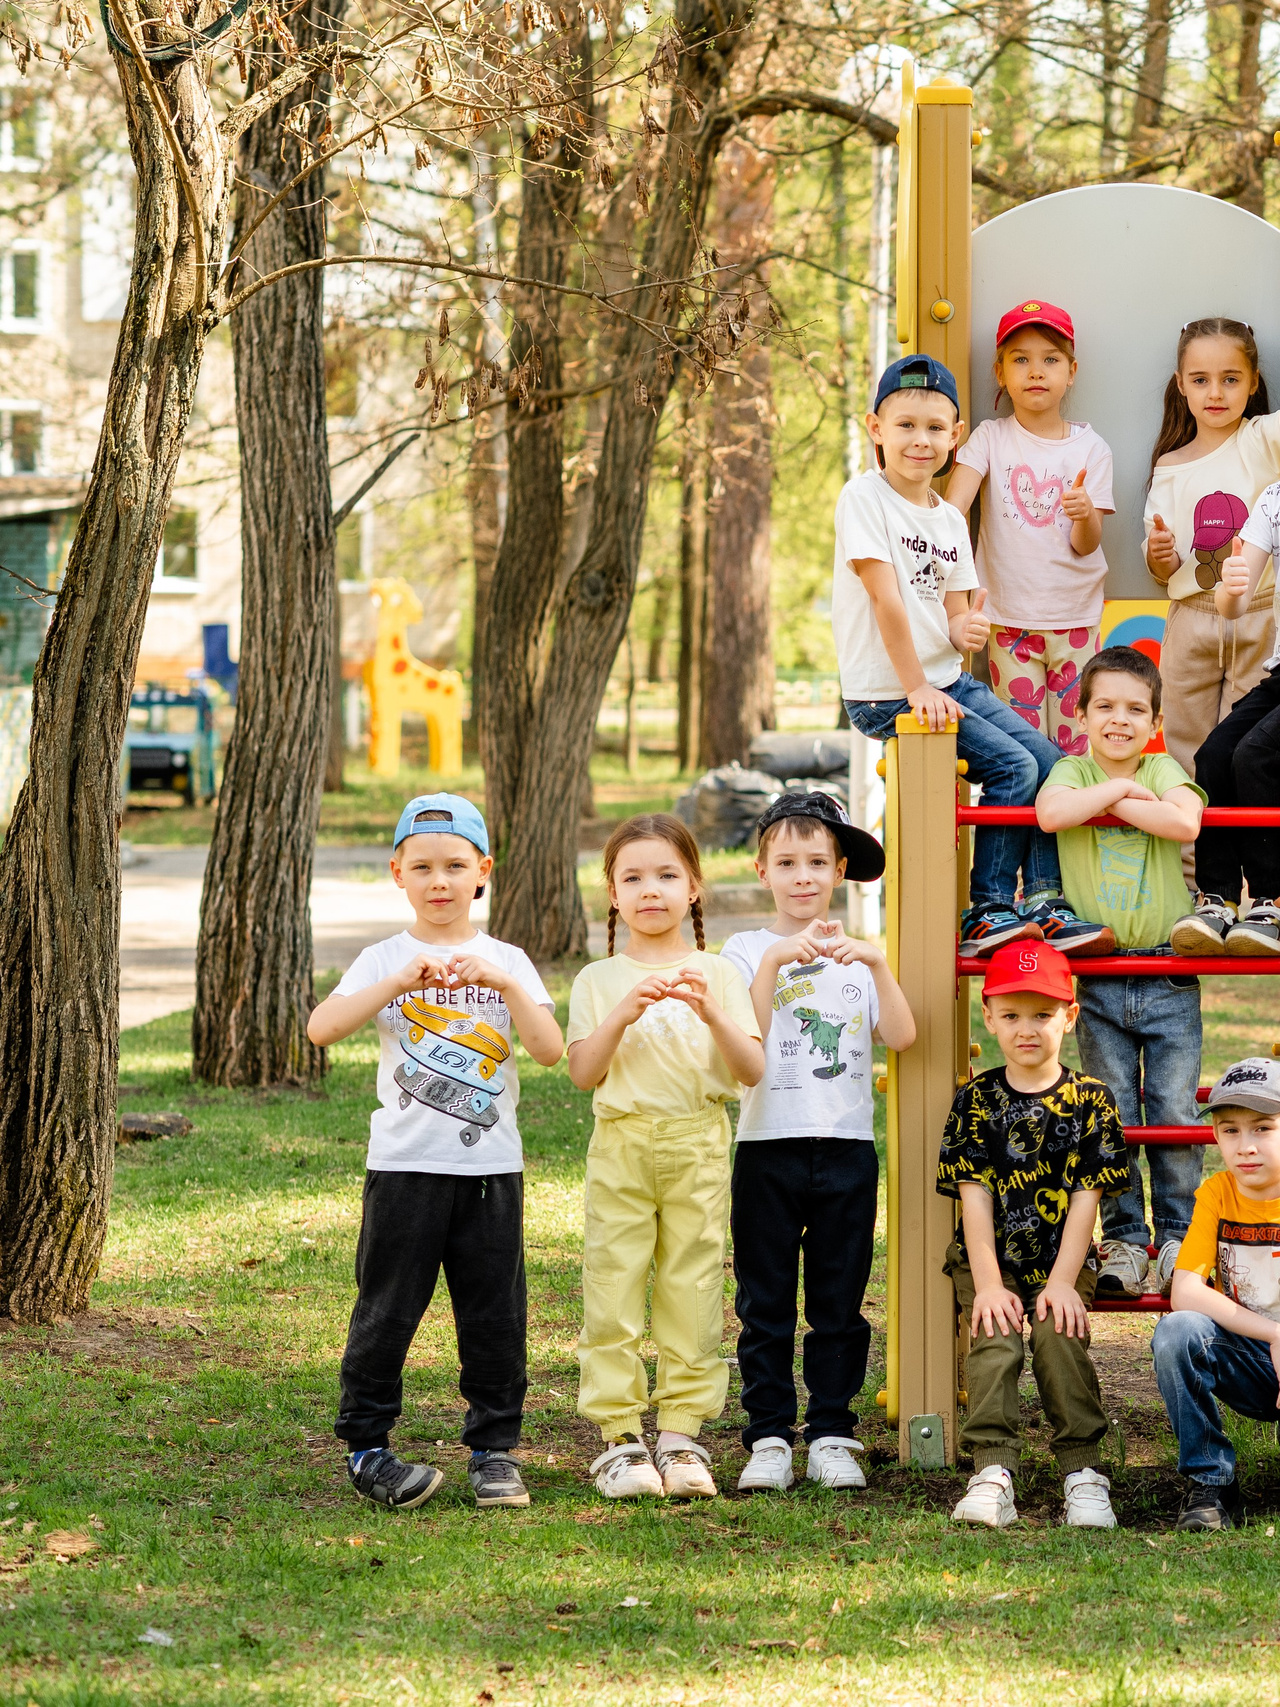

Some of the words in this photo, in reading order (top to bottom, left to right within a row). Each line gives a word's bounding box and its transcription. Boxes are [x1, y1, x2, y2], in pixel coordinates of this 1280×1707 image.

[901, 535, 928, 554] nda
[1018, 950, 1039, 974] S
[436, 987, 458, 1005] BE
[772, 979, 816, 1012] VIBES
[428, 1044, 468, 1069] 5
